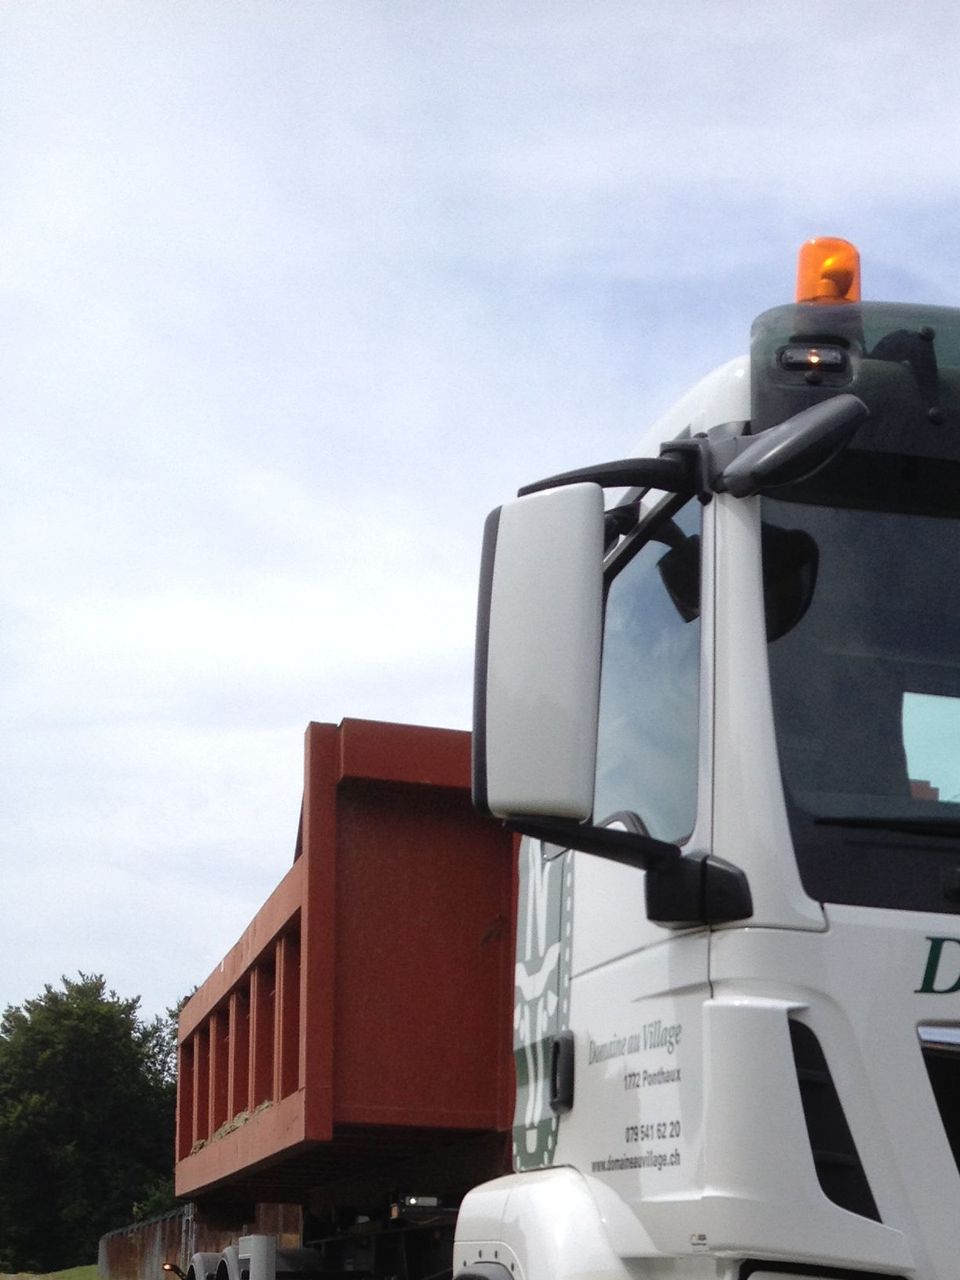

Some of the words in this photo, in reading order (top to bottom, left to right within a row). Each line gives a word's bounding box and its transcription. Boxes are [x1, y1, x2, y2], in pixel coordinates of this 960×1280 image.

[588, 1033, 626, 1065] Domaine
[627, 1033, 641, 1055] au
[643, 1020, 682, 1055] Village
[624, 1072, 640, 1090] 1772
[642, 1067, 681, 1087] Ponthaux
[625, 1126, 638, 1143] 079
[640, 1125, 654, 1141] 541
[657, 1123, 666, 1140] 62
[669, 1120, 681, 1138] 20
[591, 1148, 680, 1172] www.domaineauvillage.ch
